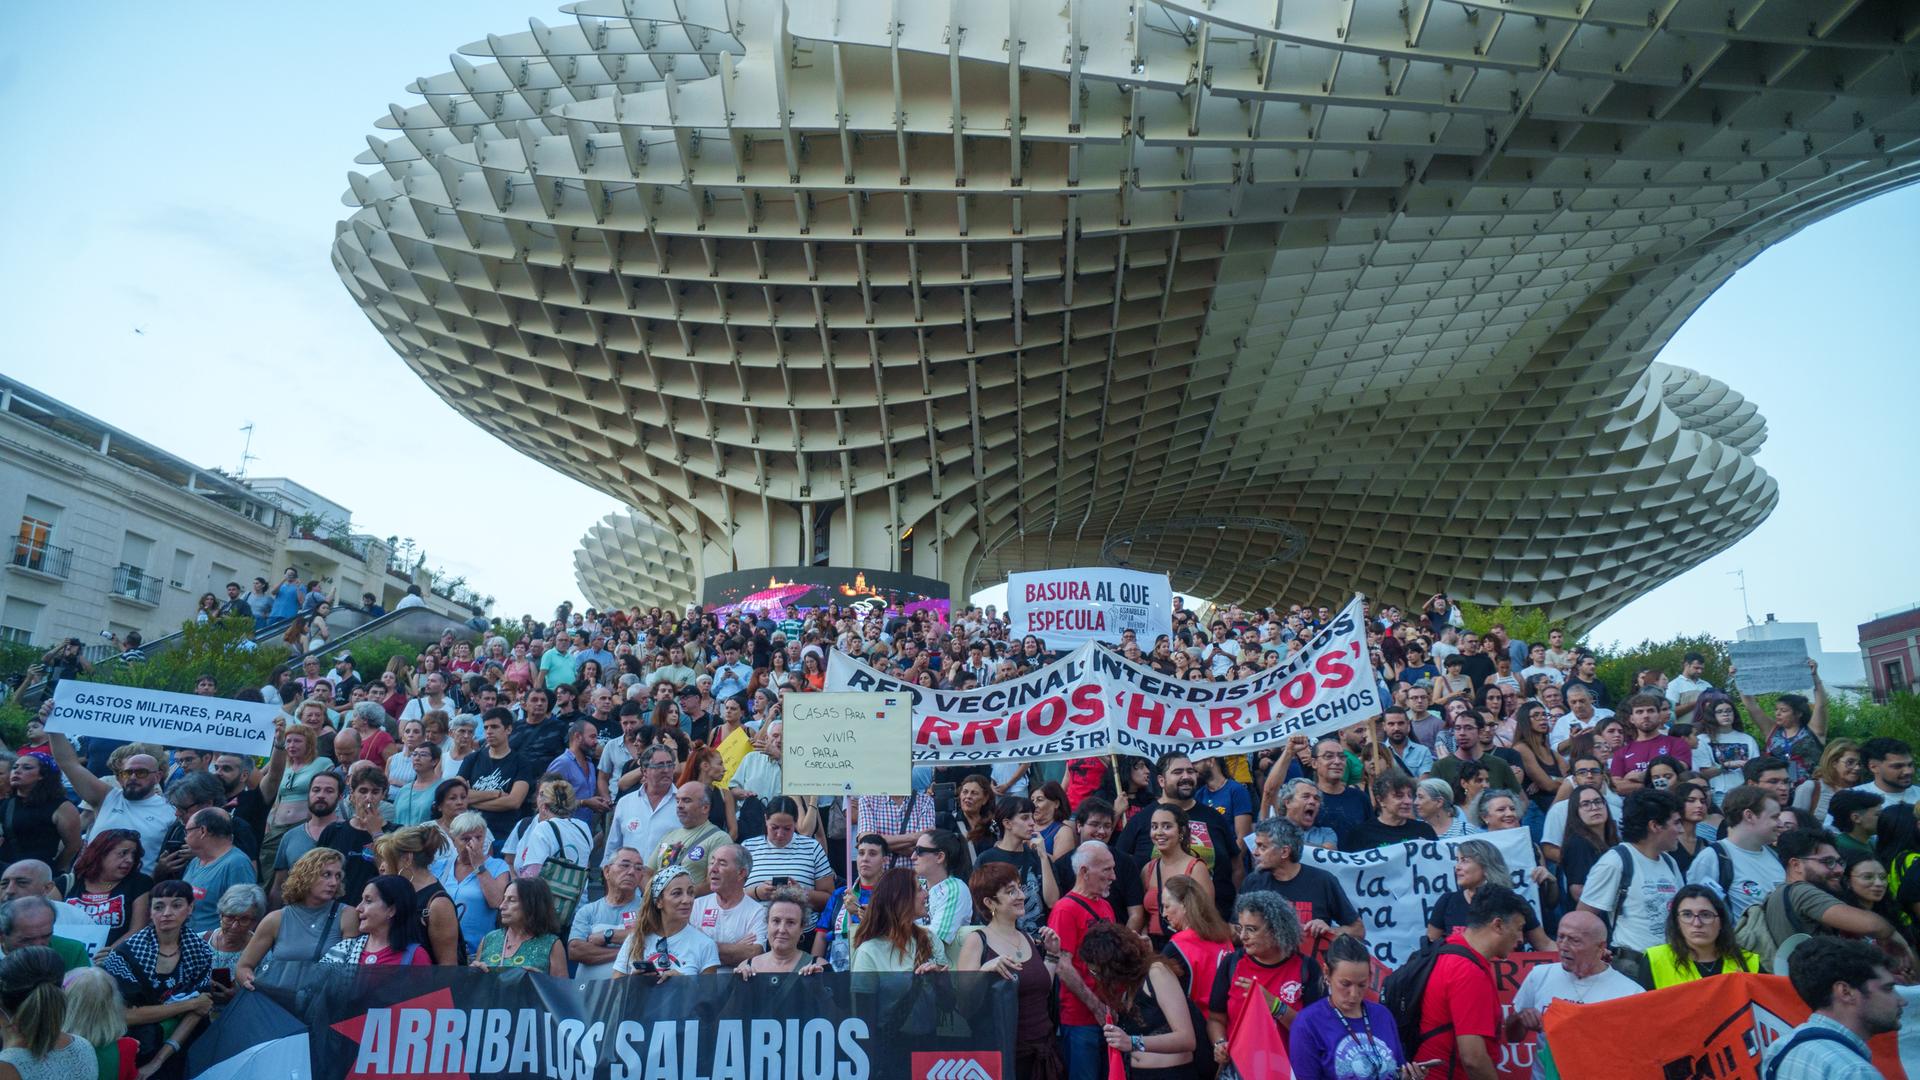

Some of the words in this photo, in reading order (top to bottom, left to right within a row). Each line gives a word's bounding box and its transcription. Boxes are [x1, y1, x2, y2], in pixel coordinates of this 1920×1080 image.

[1025, 581, 1092, 603] BASURA
[1095, 582, 1116, 602] AL
[1119, 582, 1150, 605] QUE
[1028, 609, 1106, 632] ESPECULA
[935, 661, 1083, 714] VECINAL
[75, 692, 133, 709] GASTOS
[135, 701, 210, 720] MILITARES,
[215, 709, 252, 724] PARA
[792, 703, 840, 721] CASAS
[916, 684, 1106, 746] RRIOS
[53, 706, 135, 726] CONSTRUIR
[139, 716, 202, 734] VIVIENDA
[205, 722, 267, 741] PÚBLICA
[823, 729, 857, 743] VIVIR
[949, 750, 1002, 760] POR
[1008, 727, 1110, 757] NUESTR
[1117, 729, 1224, 758] DIGNIDAD
[1231, 736, 1246, 746] Y
[1253, 689, 1374, 744] DERECHOS
[789, 745, 805, 757] NO
[812, 746, 839, 758] PARA
[804, 759, 855, 770] ESPECULAR
[1312, 847, 1389, 866] casa
[1402, 840, 1460, 867] par
[1355, 869, 1391, 898] la
[354, 1008, 539, 1074] ARRIBA
[543, 1012, 605, 1080] LOS
[610, 1017, 871, 1080] SALARIOS
